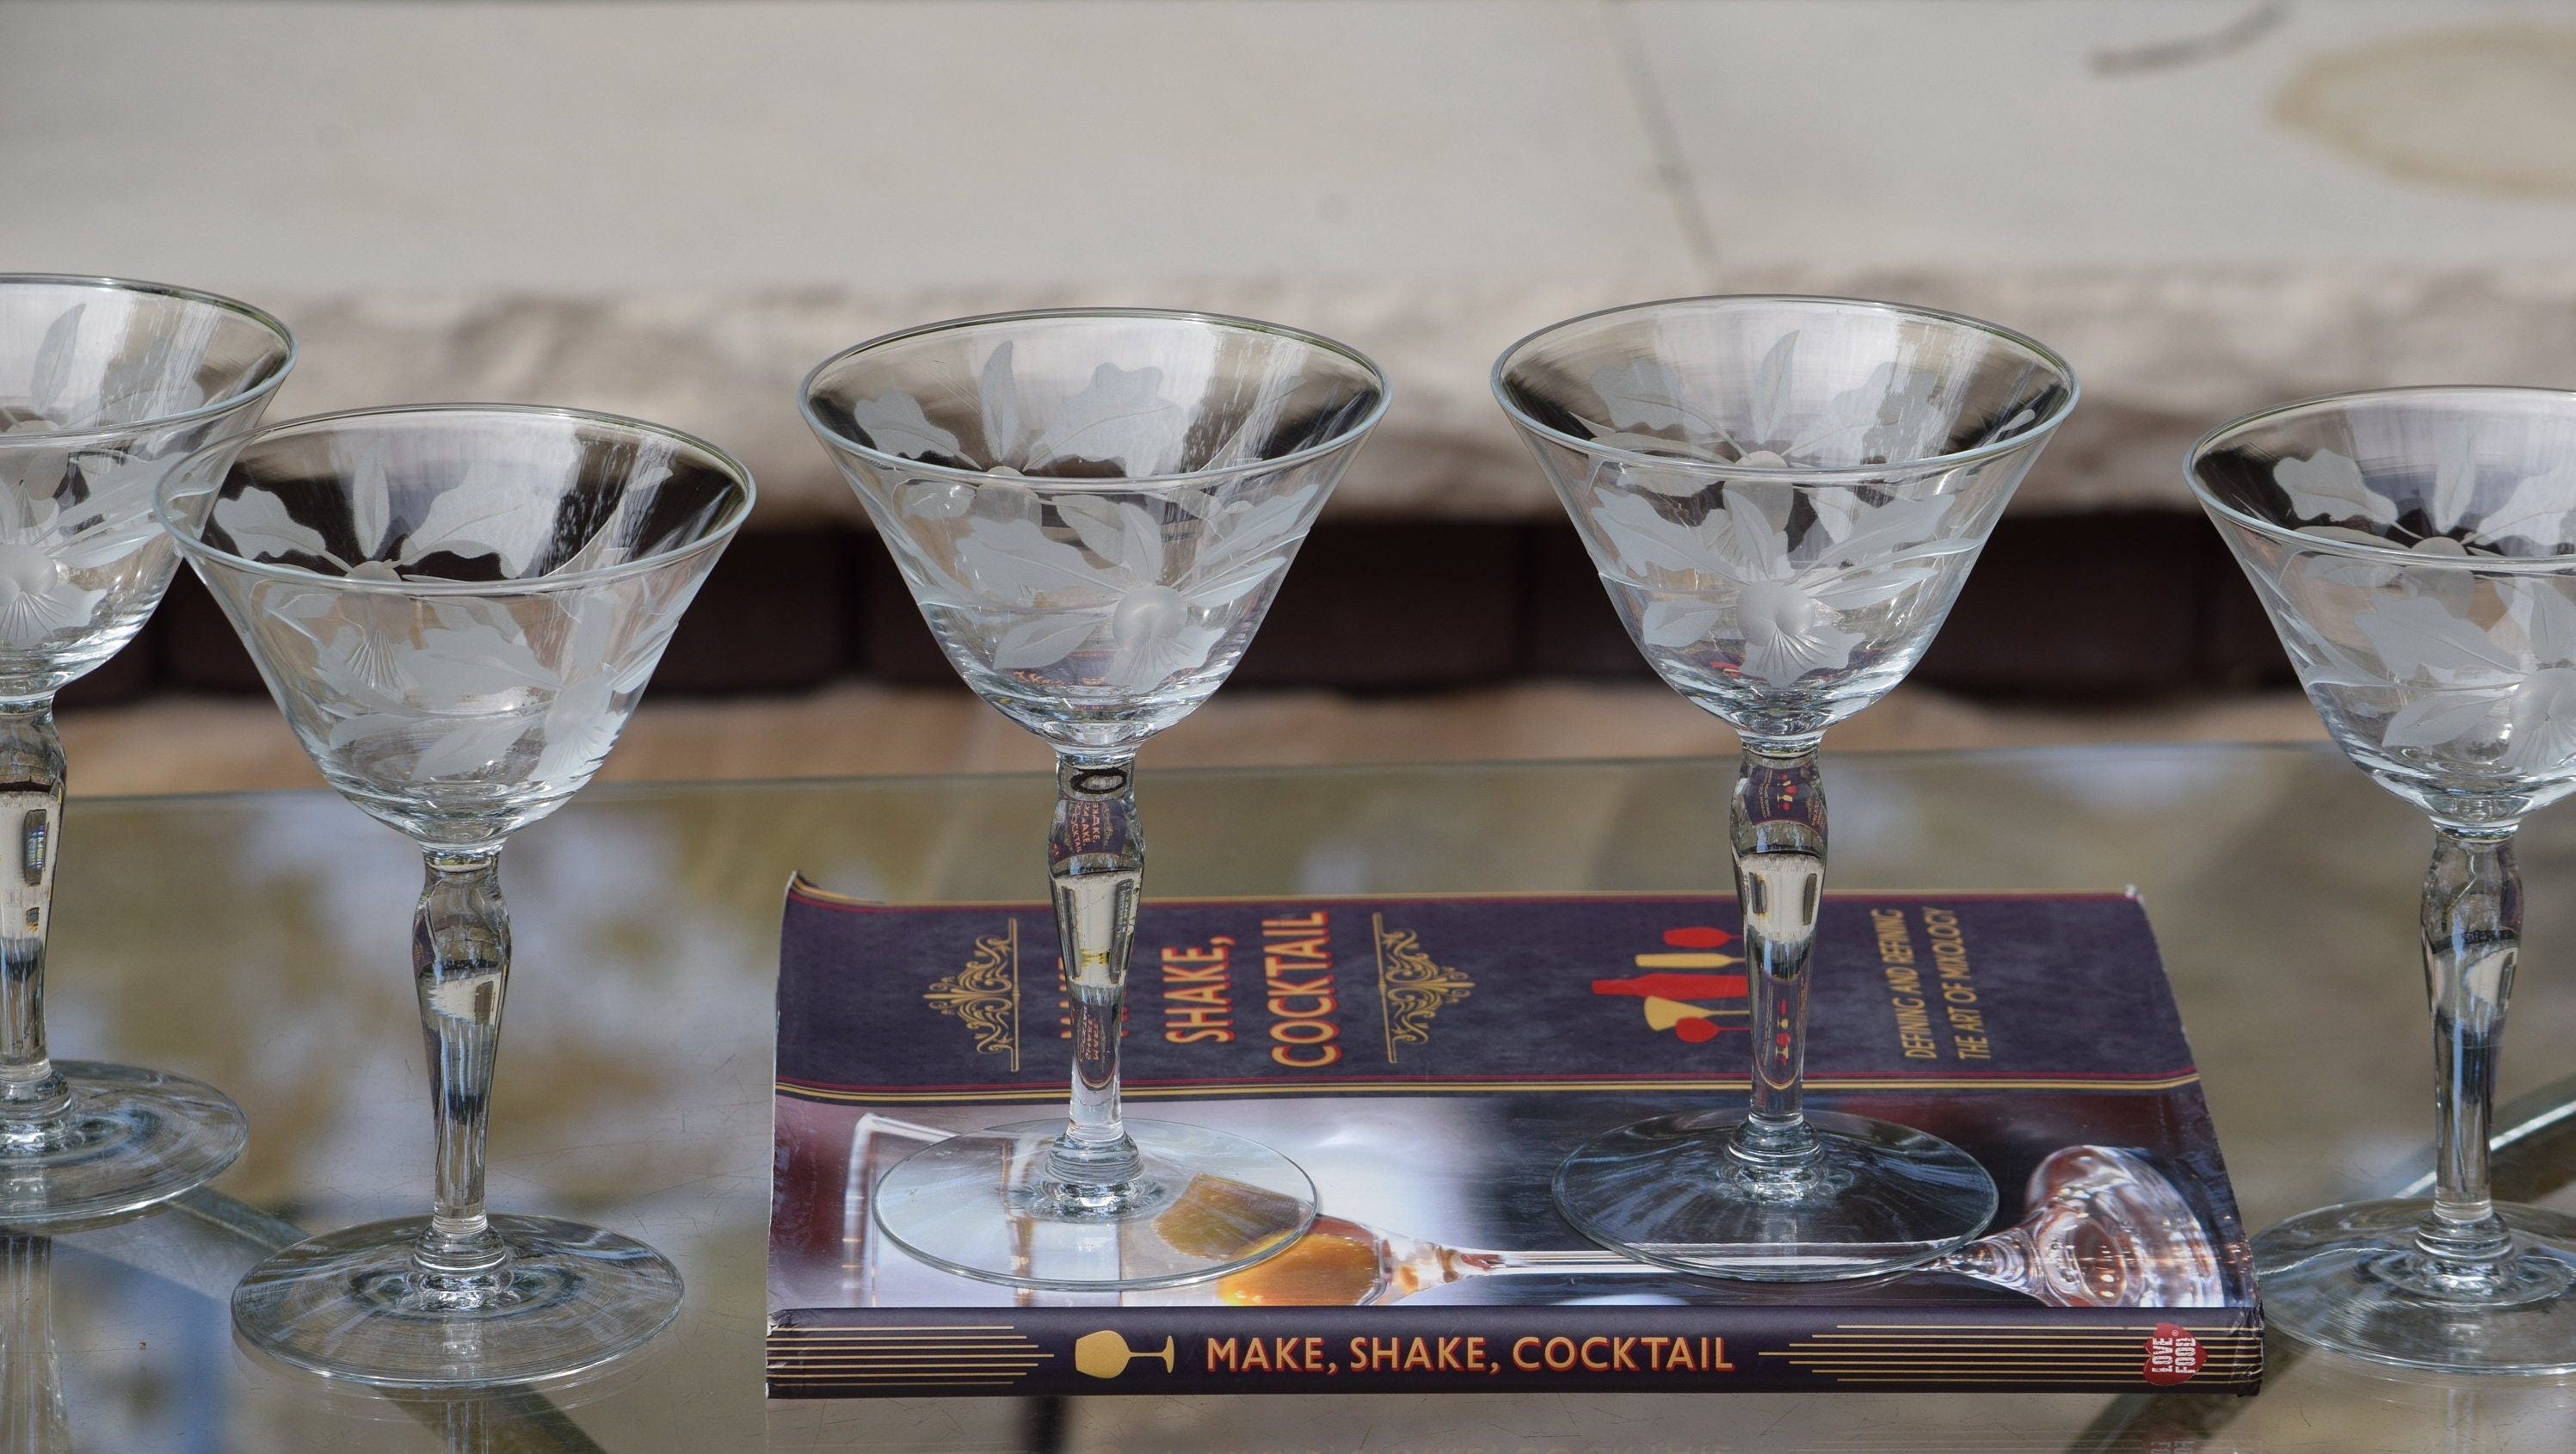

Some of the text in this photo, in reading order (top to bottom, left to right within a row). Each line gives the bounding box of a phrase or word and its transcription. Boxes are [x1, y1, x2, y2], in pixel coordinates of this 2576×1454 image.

[1162, 935, 1236, 1044] SHAKE,
[1261, 911, 1342, 1067] COCKTAIL
[1870, 909, 1938, 1059] DEFINING AND REFINING
[1921, 907, 1992, 1060] THE ART OF MIXOLOGY
[1207, 1336, 1735, 1376] MAKE, SHAKE, COCKTAIL
[2152, 1338, 2172, 1373] LOVE
[2175, 1338, 2196, 1373] FOOD
